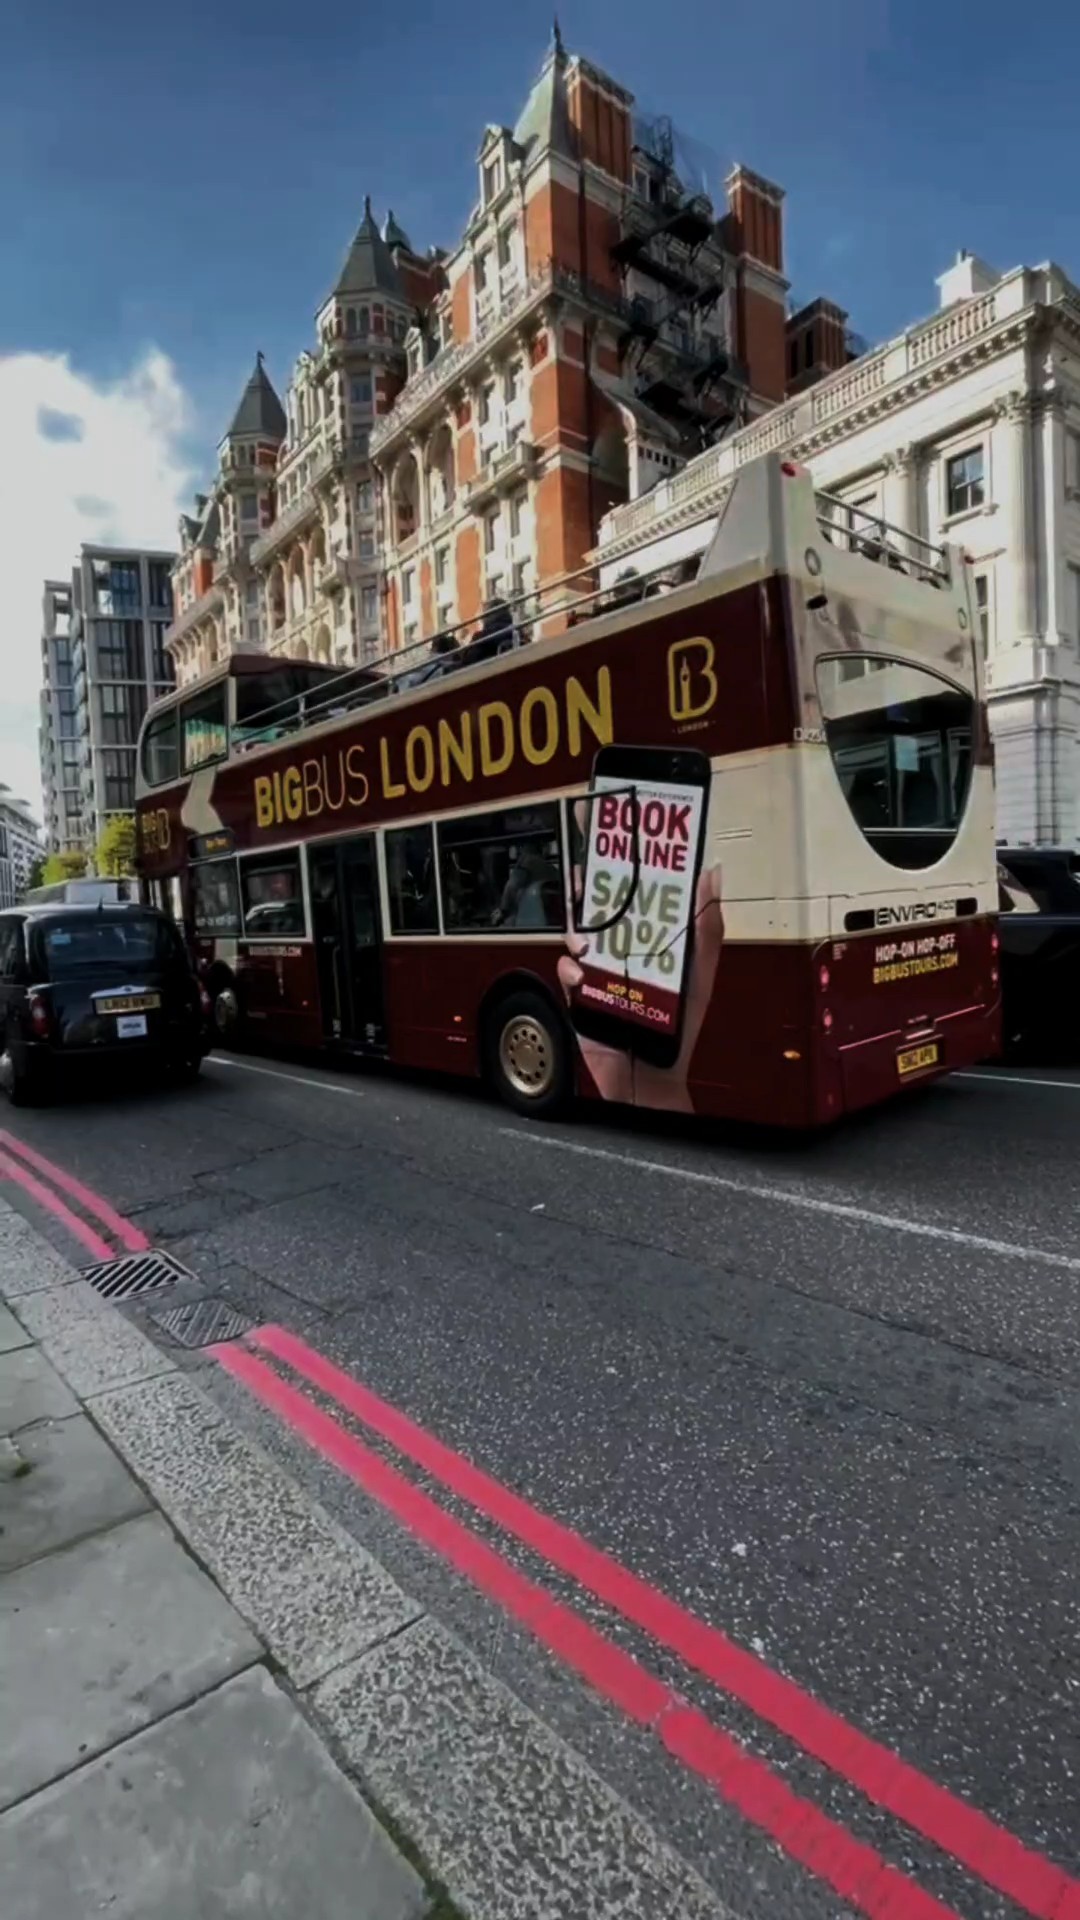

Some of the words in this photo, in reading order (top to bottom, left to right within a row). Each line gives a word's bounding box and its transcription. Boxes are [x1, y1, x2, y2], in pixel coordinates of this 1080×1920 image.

[380, 665, 614, 799] LONDON
[598, 796, 692, 842] BOOK
[595, 832, 688, 872] ONLINE
[591, 870, 683, 924] SAVE
[589, 910, 675, 976] 10%
[876, 942, 915, 963] HOP-ON
[917, 933, 956, 955] HOP-OFF
[873, 952, 958, 984] BIGBUSTOURS.COM
[607, 982, 627, 996] HOP
[629, 989, 643, 1002] ON
